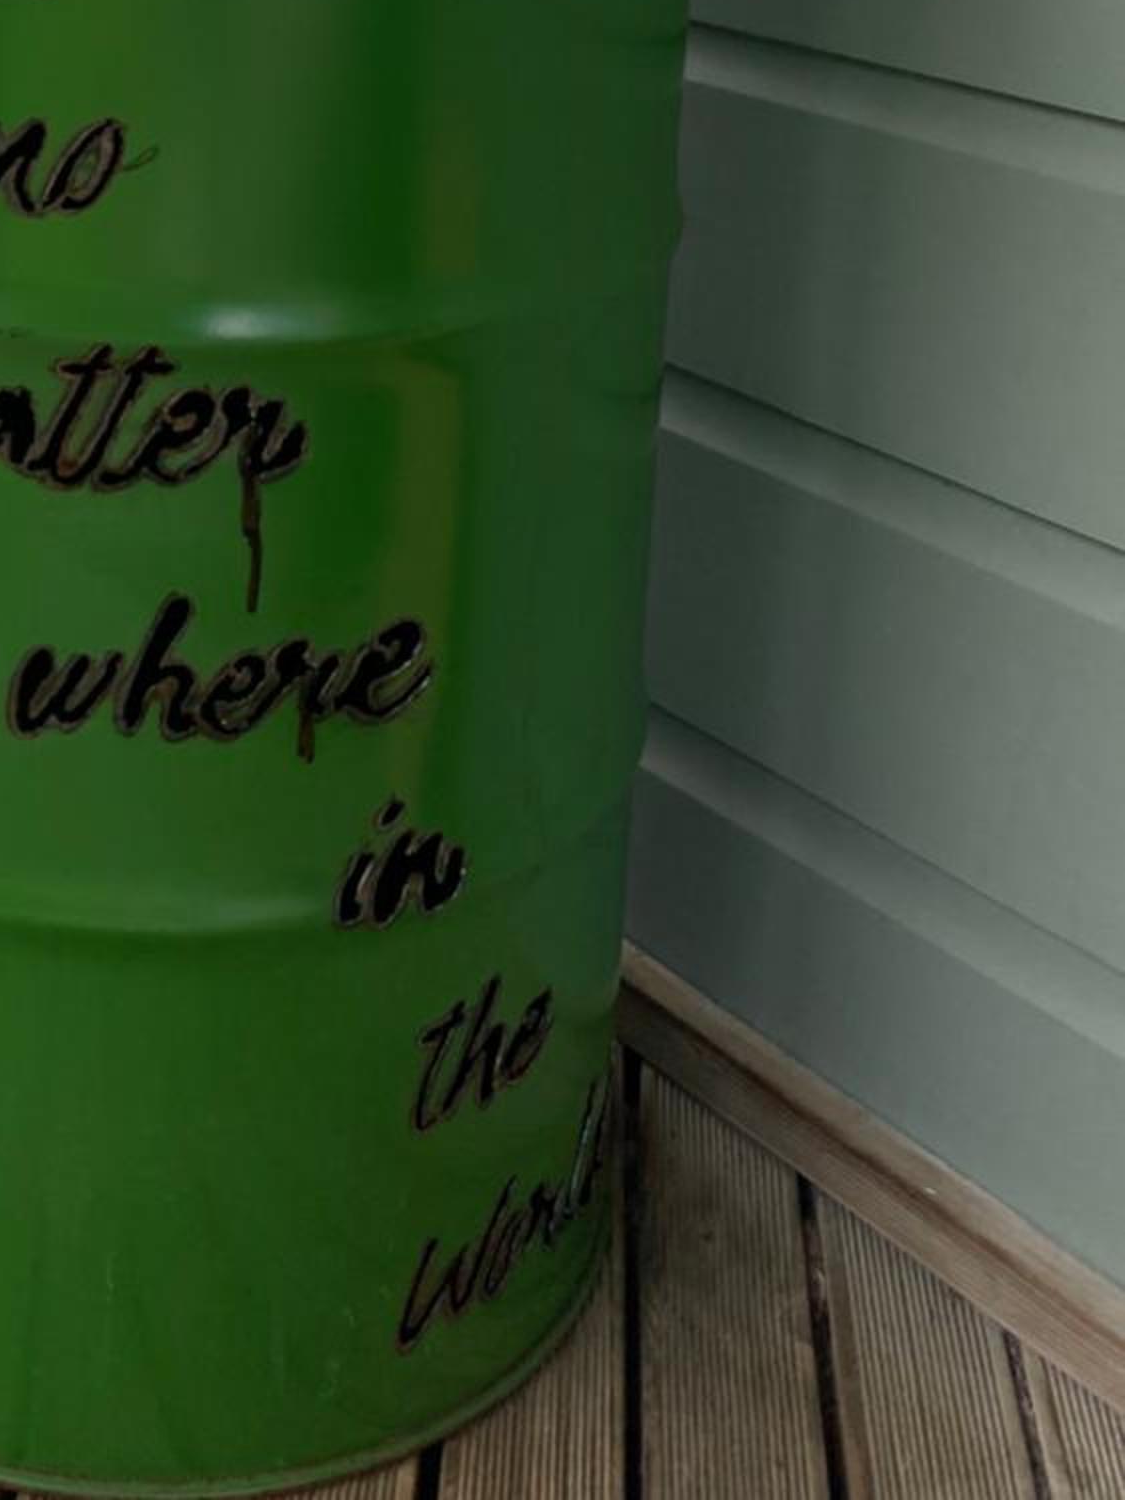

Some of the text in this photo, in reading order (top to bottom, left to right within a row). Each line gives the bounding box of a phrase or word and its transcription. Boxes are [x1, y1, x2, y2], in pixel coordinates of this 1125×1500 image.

[6, 590, 435, 744] where
[335, 795, 468, 928] in
[412, 970, 555, 1132] the
